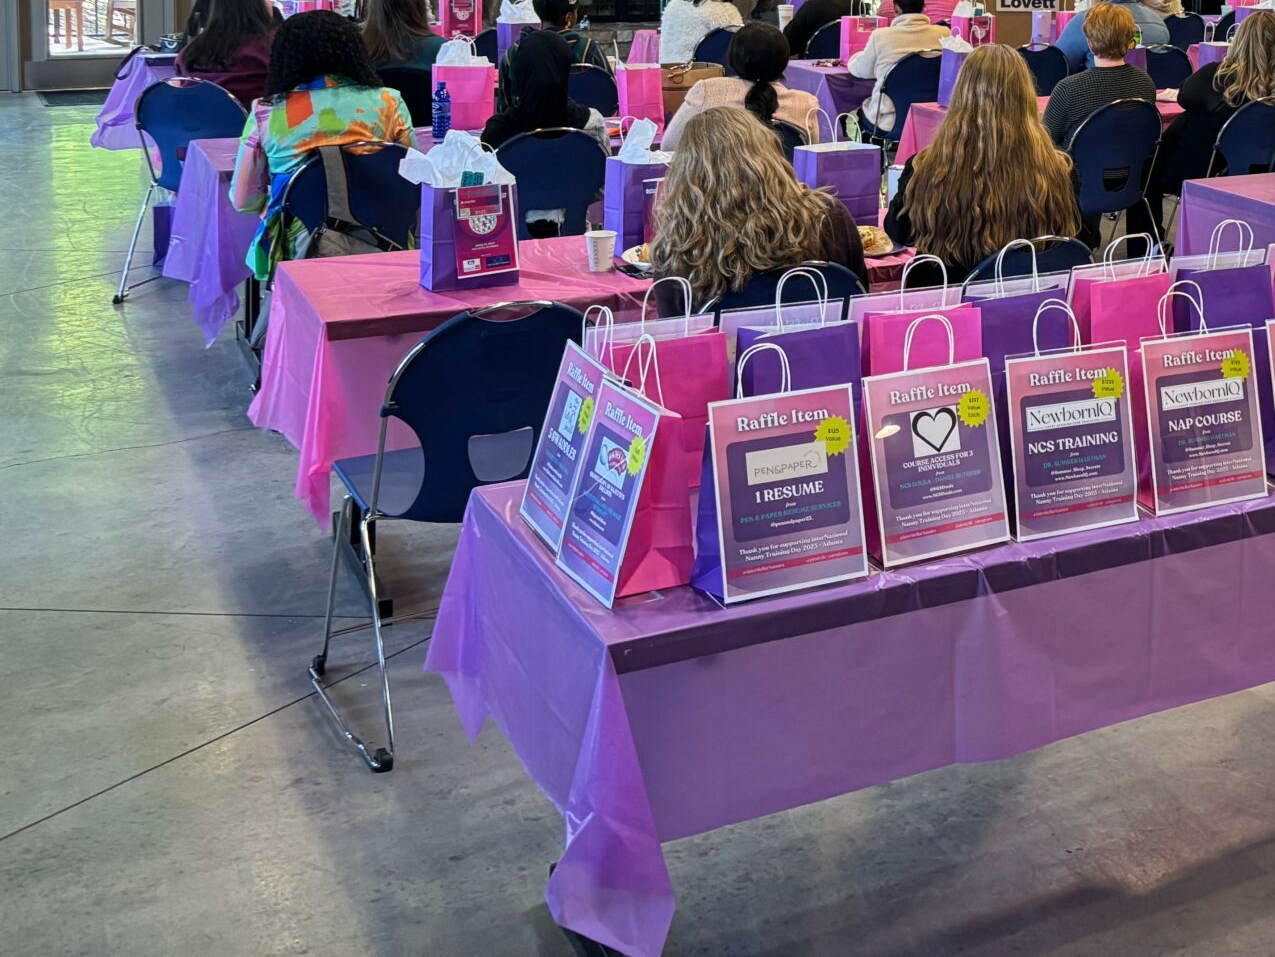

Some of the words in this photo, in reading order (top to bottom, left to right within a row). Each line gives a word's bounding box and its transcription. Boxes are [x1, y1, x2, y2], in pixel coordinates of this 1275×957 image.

[1163, 350, 1204, 368] Raffle
[1204, 348, 1236, 362] Item
[567, 361, 585, 384] Raffle
[581, 372, 595, 394] Item
[1029, 370, 1073, 387] Raffle
[1075, 367, 1108, 381] Item
[890, 386, 935, 405] Raffle
[938, 382, 972, 397] Item
[1164, 381, 1241, 406] NewbornIQ
[604, 401, 628, 426] Raffle
[625, 416, 644, 437] Item
[736, 412, 788, 432] Raffle
[791, 408, 830, 424] Item
[1030, 401, 1114, 427] NewbornIQ
[1168, 418, 1194, 432] NAP
[1195, 410, 1242, 428] COURSE
[1028, 440, 1055, 455] NCS
[1056, 431, 1118, 451] TRAINING
[754, 458, 812, 478] PEN&PAPER
[902, 458, 930, 469] COURSE
[930, 454, 955, 465] ACCESS
[954, 451, 969, 460] FOR
[918, 459, 961, 472] INDIVIDUALS
[1167, 468, 1182, 476] Thank
[1182, 467, 1191, 475] you
[1198, 460, 1223, 472] supporting
[1206, 468, 1216, 476] Day
[755, 490, 762, 504] 1
[763, 480, 824, 502] RESUME
[1030, 492, 1046, 500] Thank
[1064, 484, 1092, 495] supporting
[1036, 498, 1052, 506] Nanny
[1052, 495, 1074, 504] Training
[1074, 492, 1084, 500] Day
[895, 512, 912, 522] Thank
[912, 512, 923, 520] you
[931, 504, 959, 516] supporting
[900, 519, 918, 528] Nanny
[918, 515, 942, 525] Training
[941, 512, 952, 521] Day
[738, 546, 758, 556] Thank
[758, 546, 770, 555] you
[779, 537, 811, 550] supporting
[745, 554, 765, 562] Nanny
[764, 549, 790, 560] Training
[790, 546, 802, 556] Day
[822, 539, 844, 548] Atlanta
